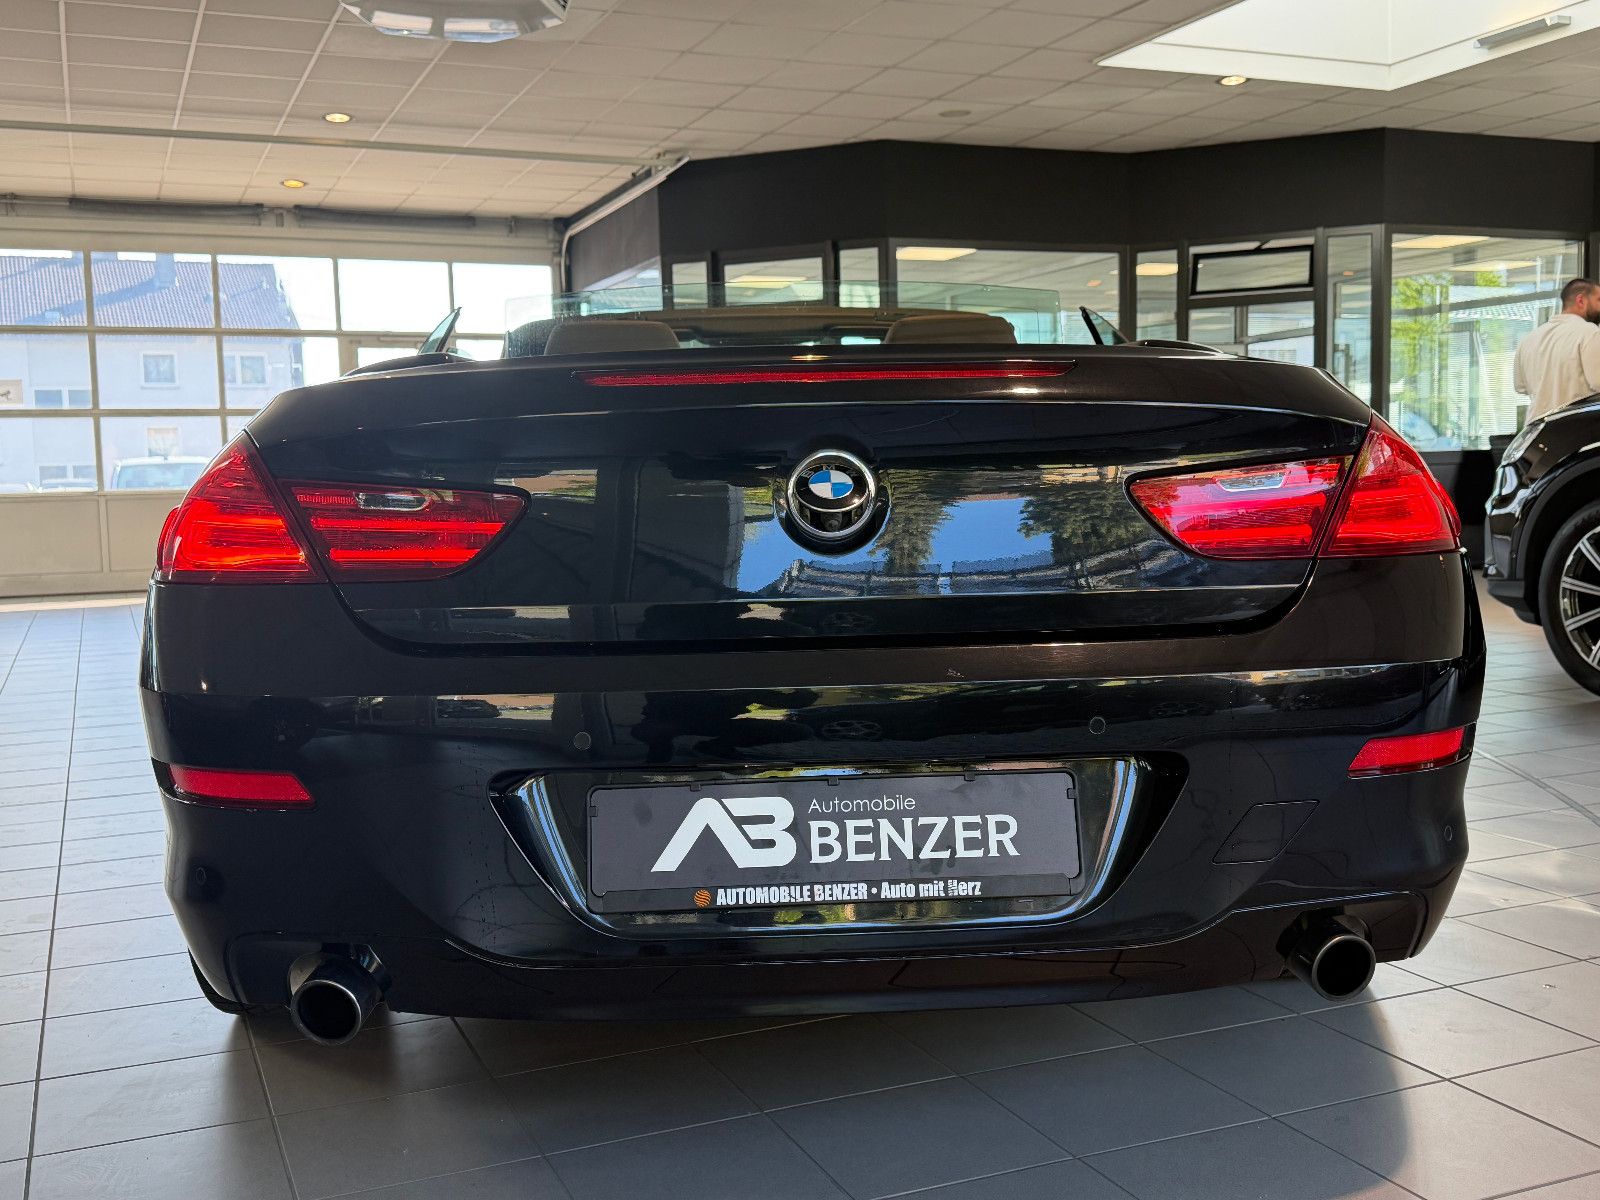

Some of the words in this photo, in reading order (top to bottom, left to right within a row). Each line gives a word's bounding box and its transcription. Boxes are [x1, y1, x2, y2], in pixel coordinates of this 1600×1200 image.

[807, 794, 916, 814] Automobile
[651, 796, 797, 872] AB
[807, 813, 1021, 864] BENZER
[716, 884, 812, 906] AUTOMOBILE
[813, 882, 868, 902] BENZER
[880, 881, 916, 899] Auto
[919, 880, 946, 898] mit
[947, 878, 982, 897] Herz
